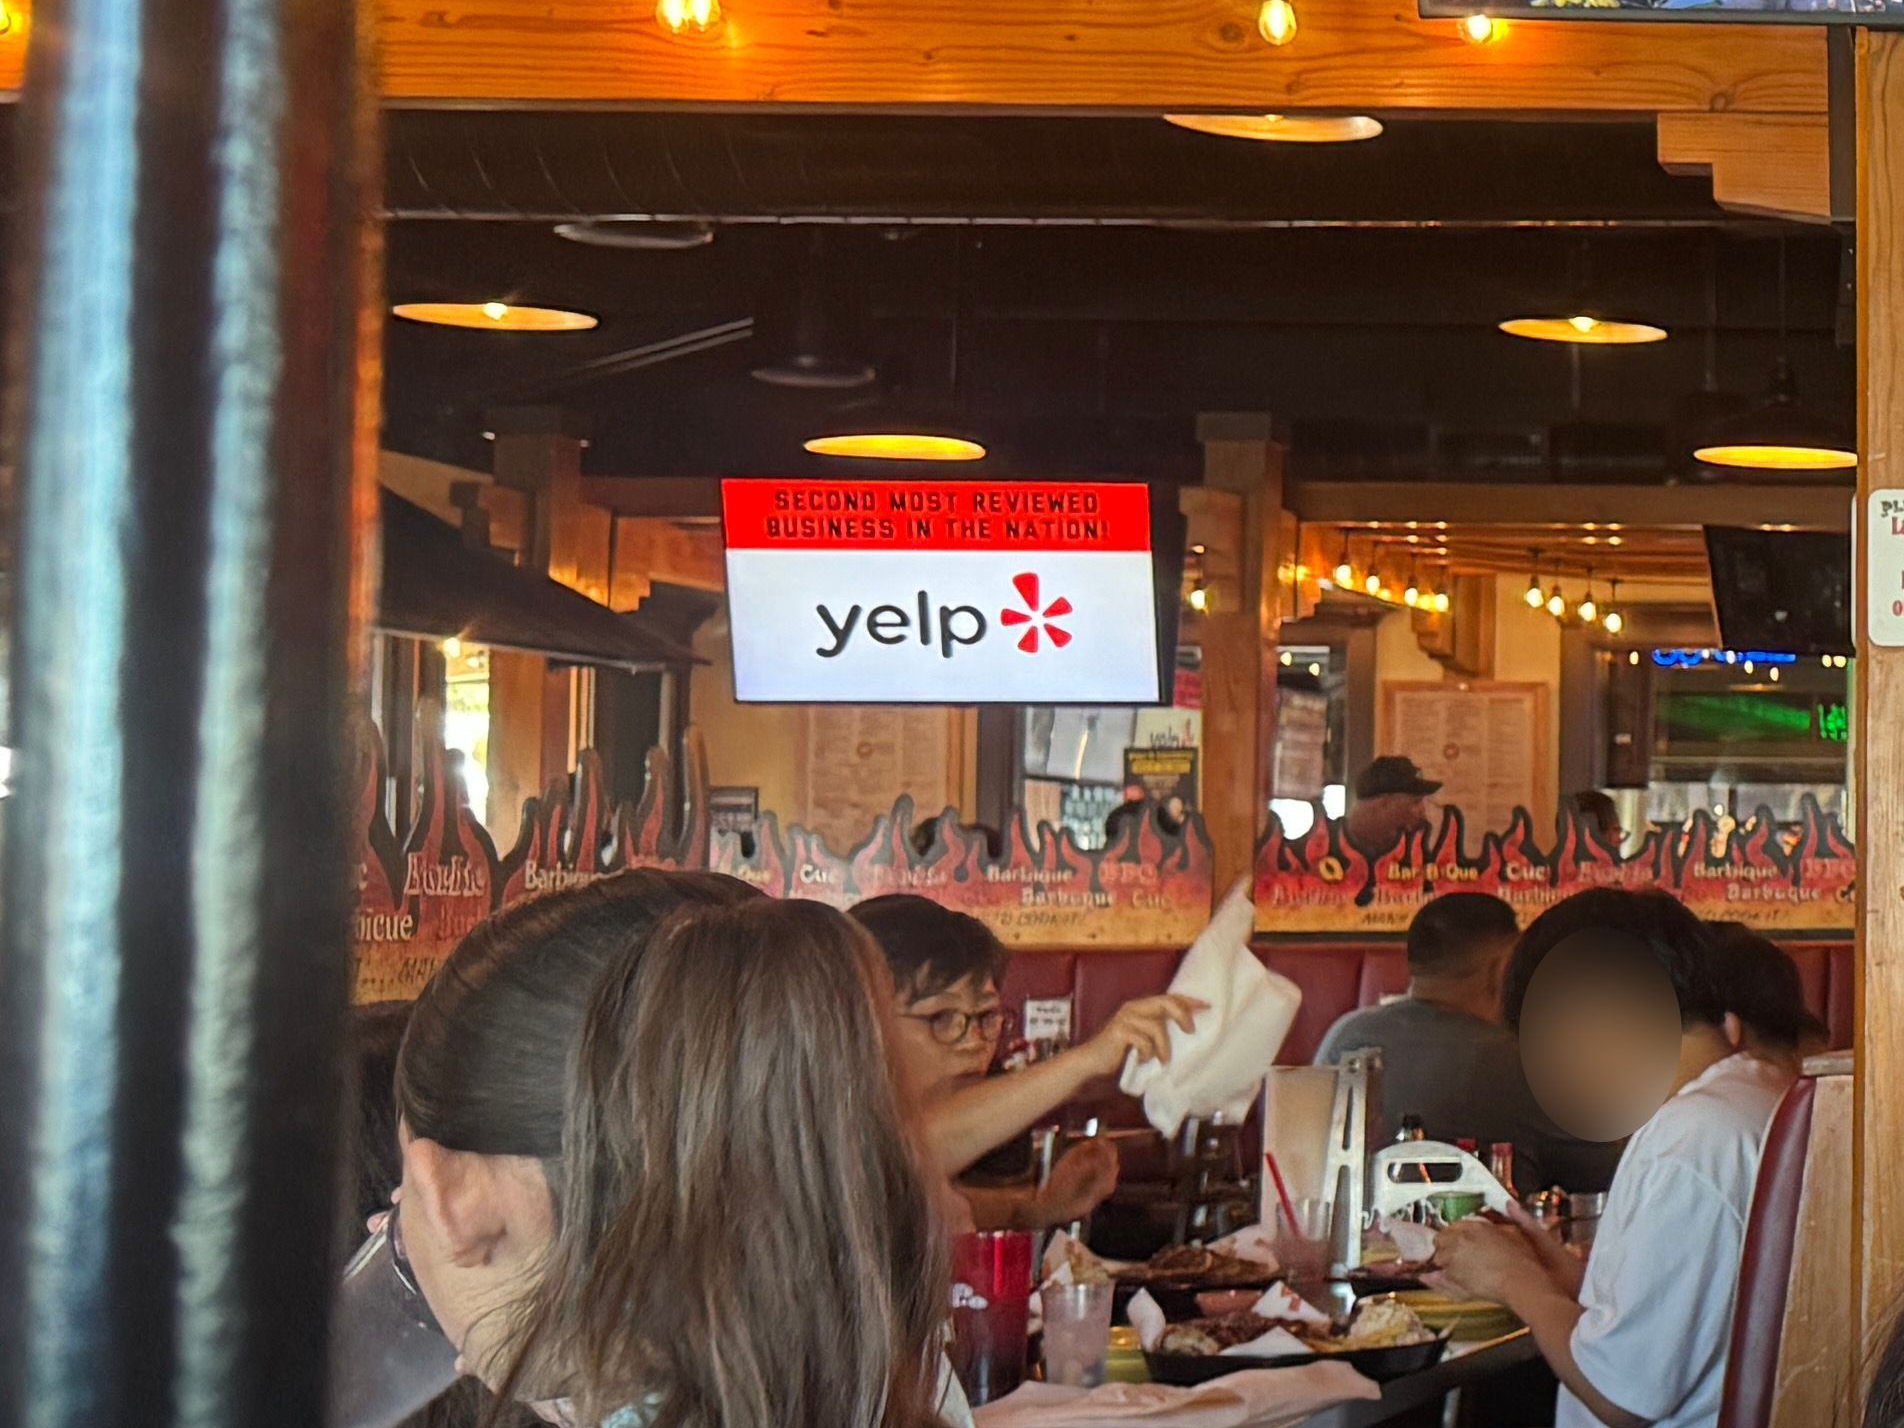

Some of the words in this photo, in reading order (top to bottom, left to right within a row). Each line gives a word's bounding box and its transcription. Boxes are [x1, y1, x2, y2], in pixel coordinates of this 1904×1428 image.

[774, 491, 876, 512] SECOND
[889, 491, 958, 513] MOST
[973, 493, 1099, 513] REVIEWED
[767, 519, 895, 538] BUSINESS
[907, 520, 932, 539] IN
[946, 520, 992, 539] THE
[1005, 520, 1110, 540] NATION!
[816, 590, 987, 658] yelp
